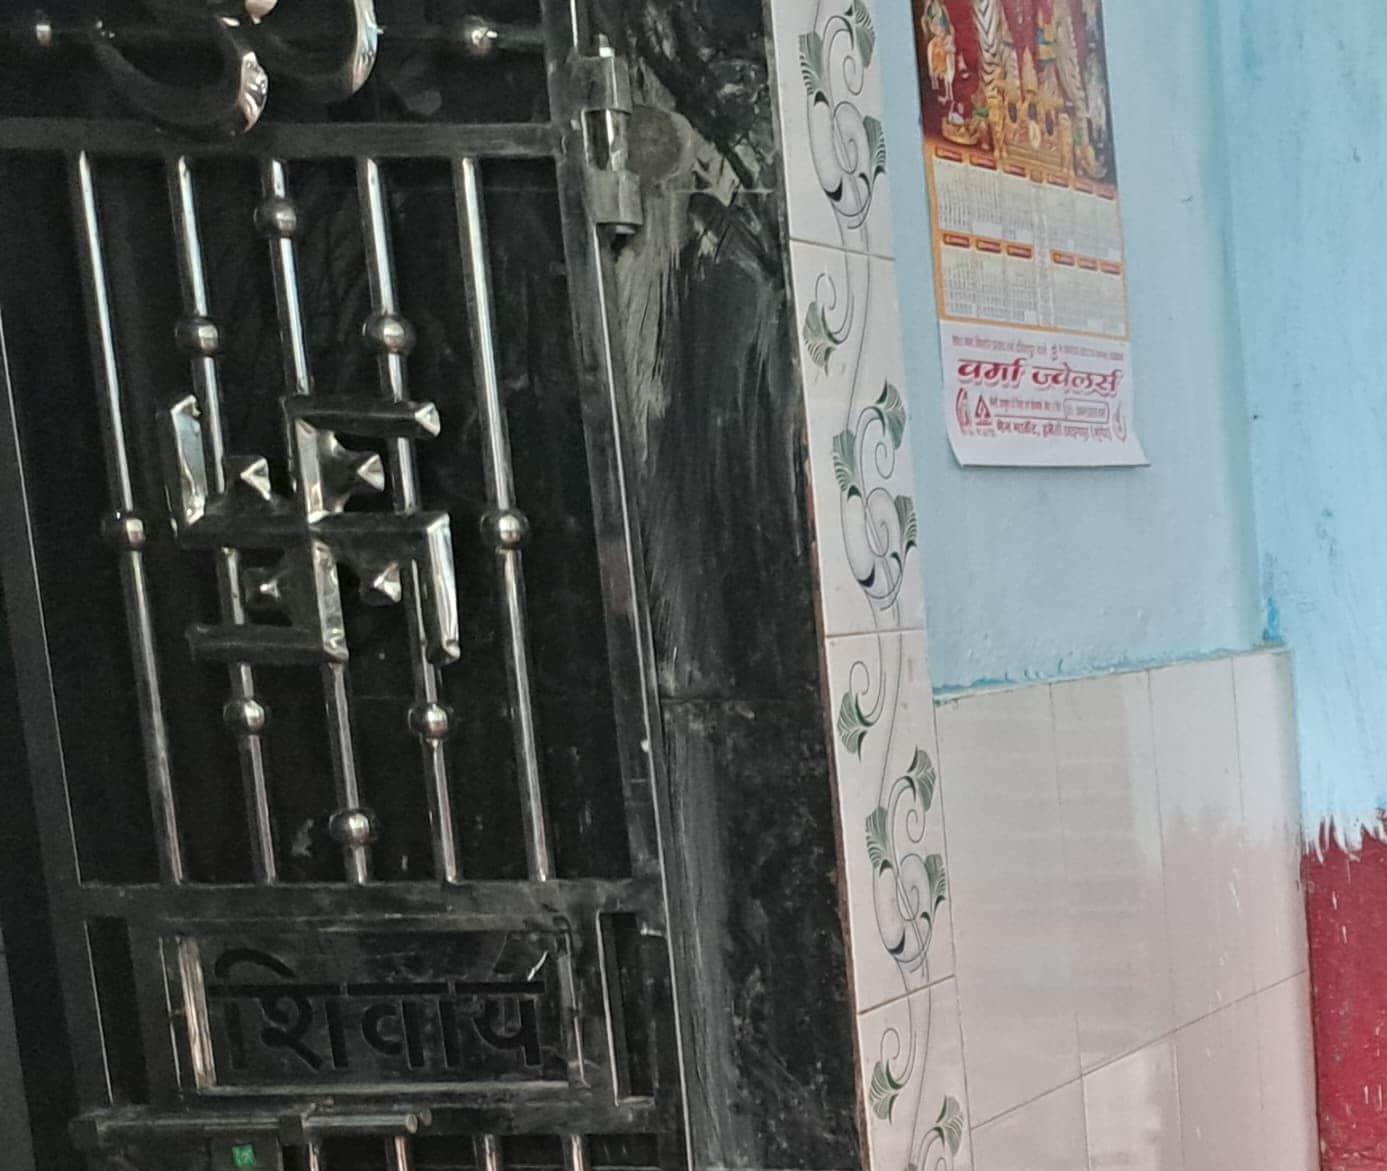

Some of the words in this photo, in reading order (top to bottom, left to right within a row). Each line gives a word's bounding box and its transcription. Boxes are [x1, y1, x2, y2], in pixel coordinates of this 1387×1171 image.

[957, 357, 1026, 385] वर्मा
[1032, 362, 1124, 394] ज्वेलर्स
[207, 947, 545, 1070] शिवाय
